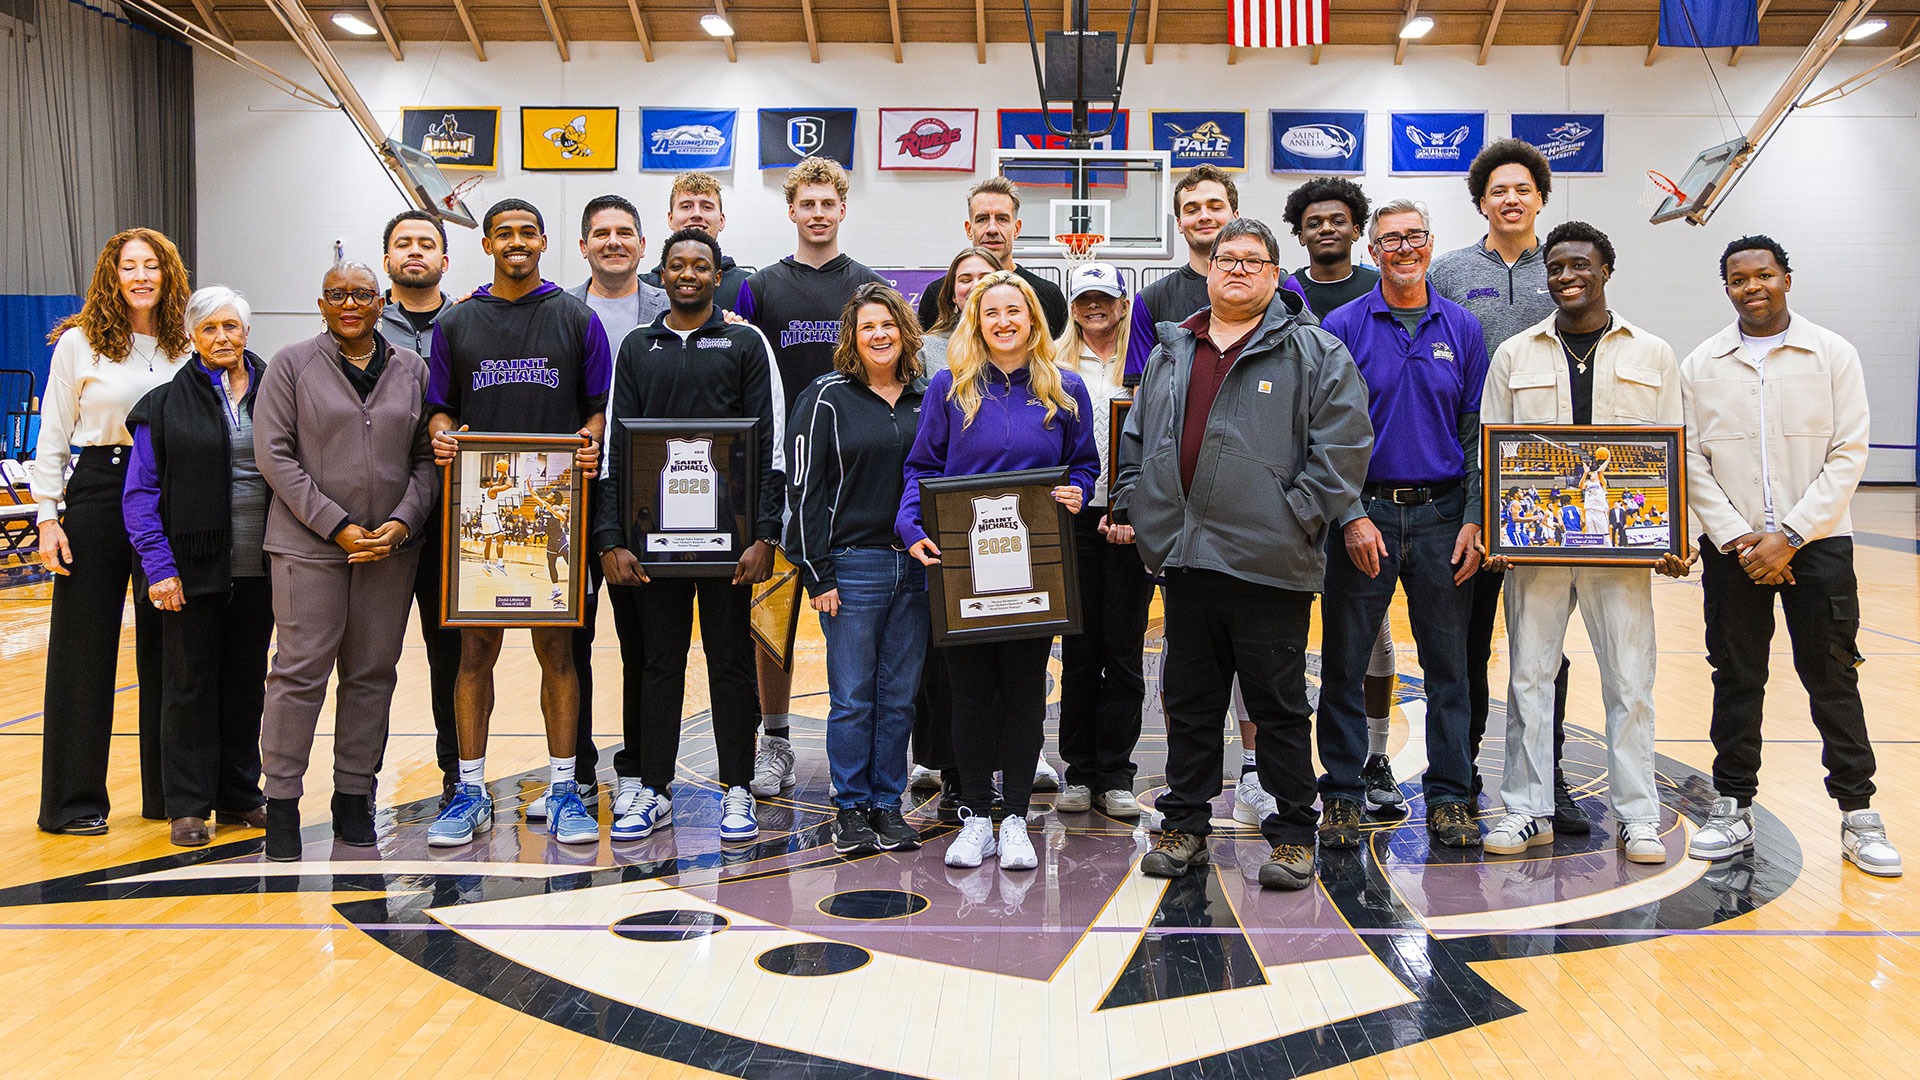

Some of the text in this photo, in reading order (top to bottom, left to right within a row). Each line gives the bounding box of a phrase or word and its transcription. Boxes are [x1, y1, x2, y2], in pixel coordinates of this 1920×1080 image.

[795, 122, 818, 147] B
[895, 128, 962, 157] RAVENS
[421, 137, 475, 155] ADELPHI
[652, 139, 720, 152] ASSUMPTION
[1173, 138, 1229, 151] PACE
[480, 358, 548, 371] SAINT
[668, 478, 710, 494] 2026
[981, 516, 1013, 524] SAINT
[977, 535, 1022, 555] 2026
